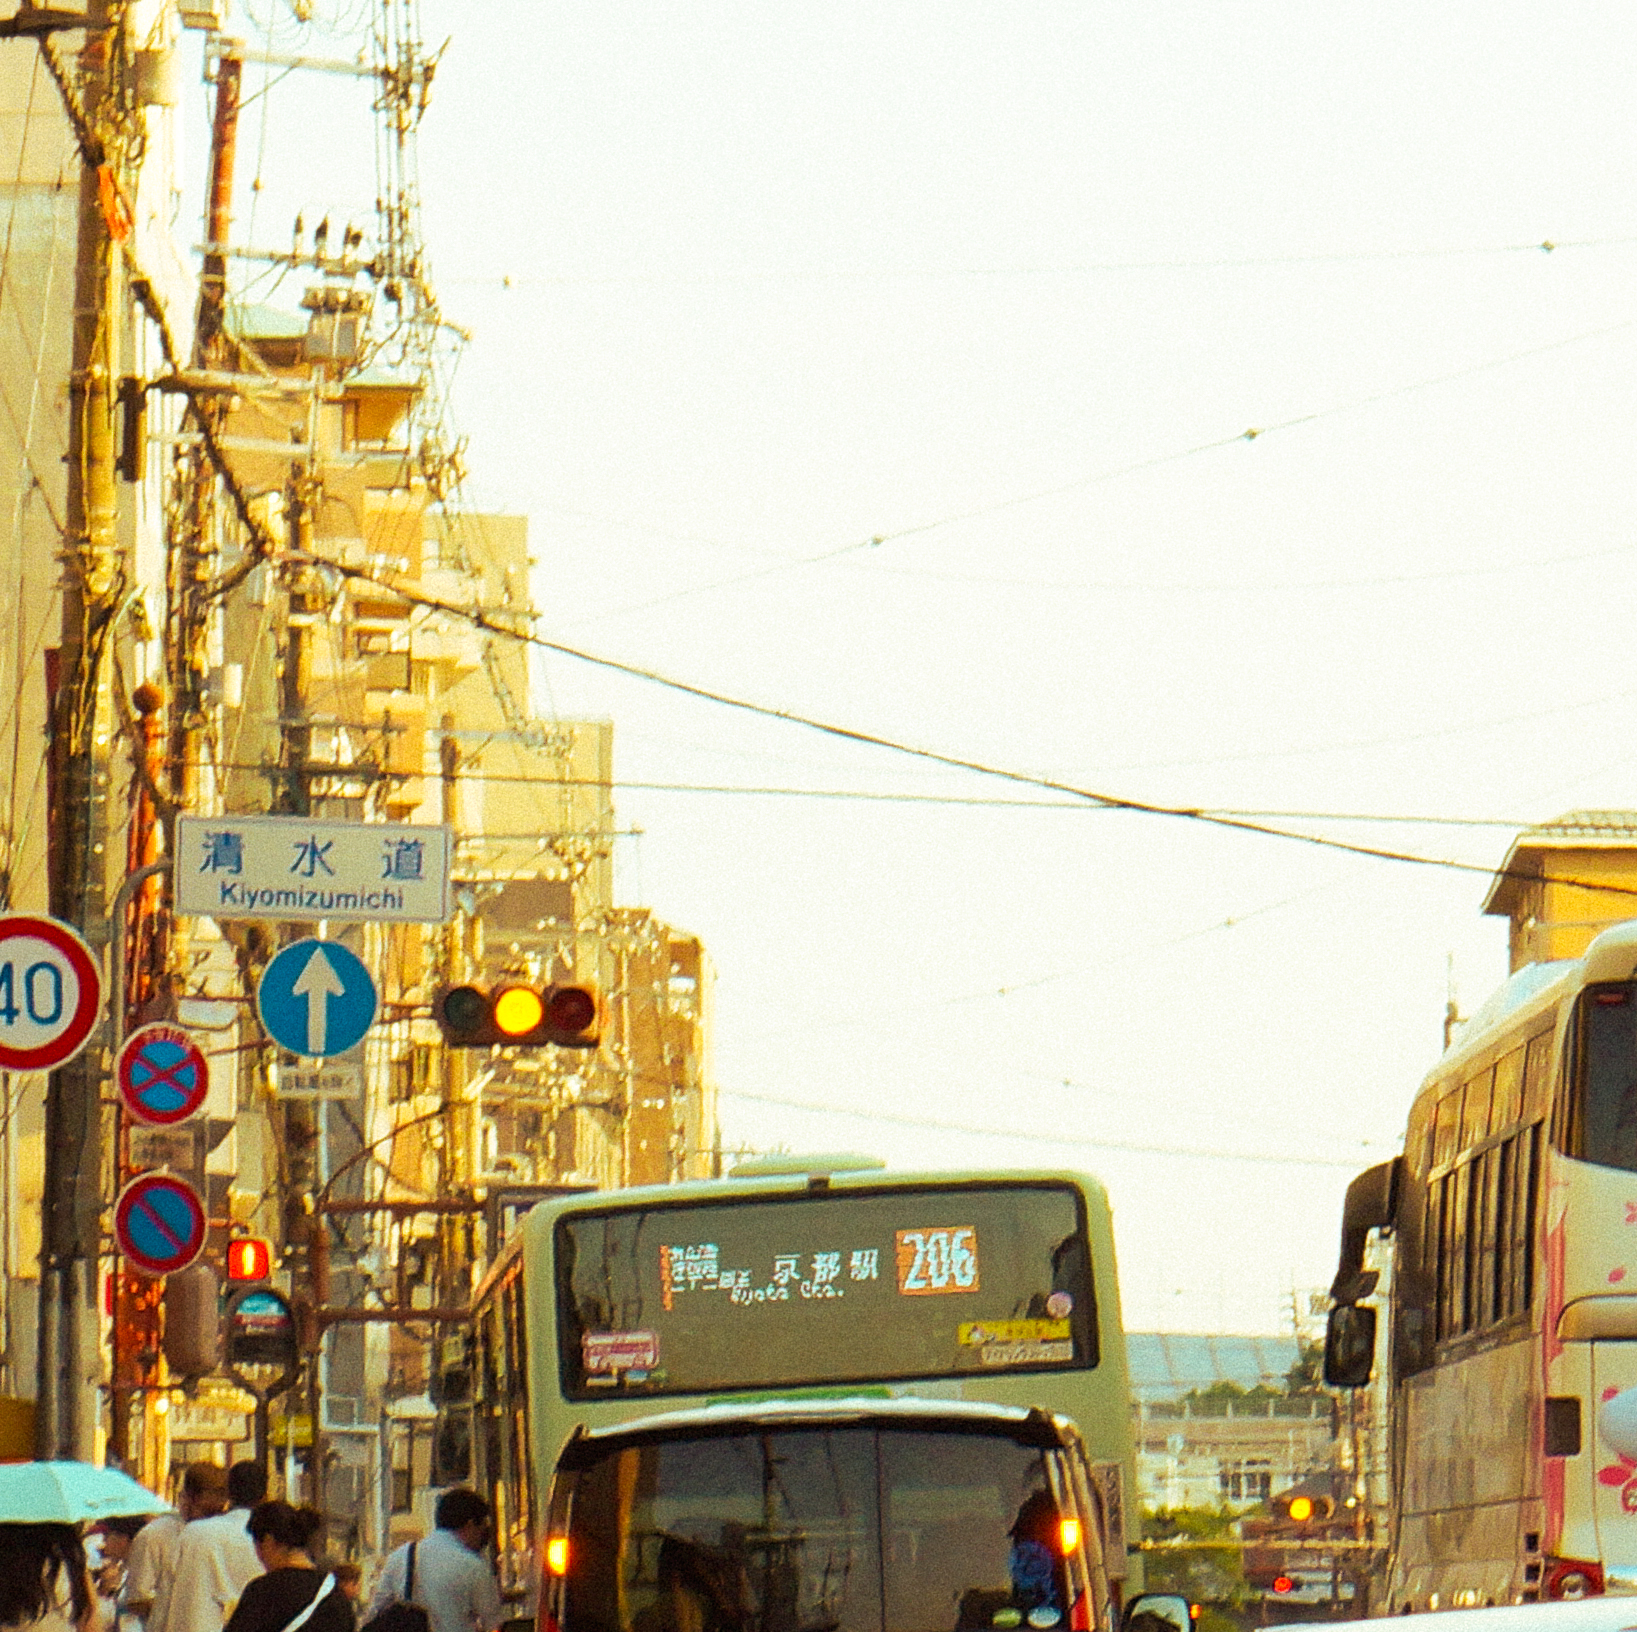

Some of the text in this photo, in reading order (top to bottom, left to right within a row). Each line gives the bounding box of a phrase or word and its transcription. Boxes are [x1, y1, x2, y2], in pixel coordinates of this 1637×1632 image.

[200, 831, 424, 880] 清水道
[220, 880, 404, 910] Kiyomizumichi
[0, 961, 63, 1026] 40
[903, 1230, 975, 1290] 206
